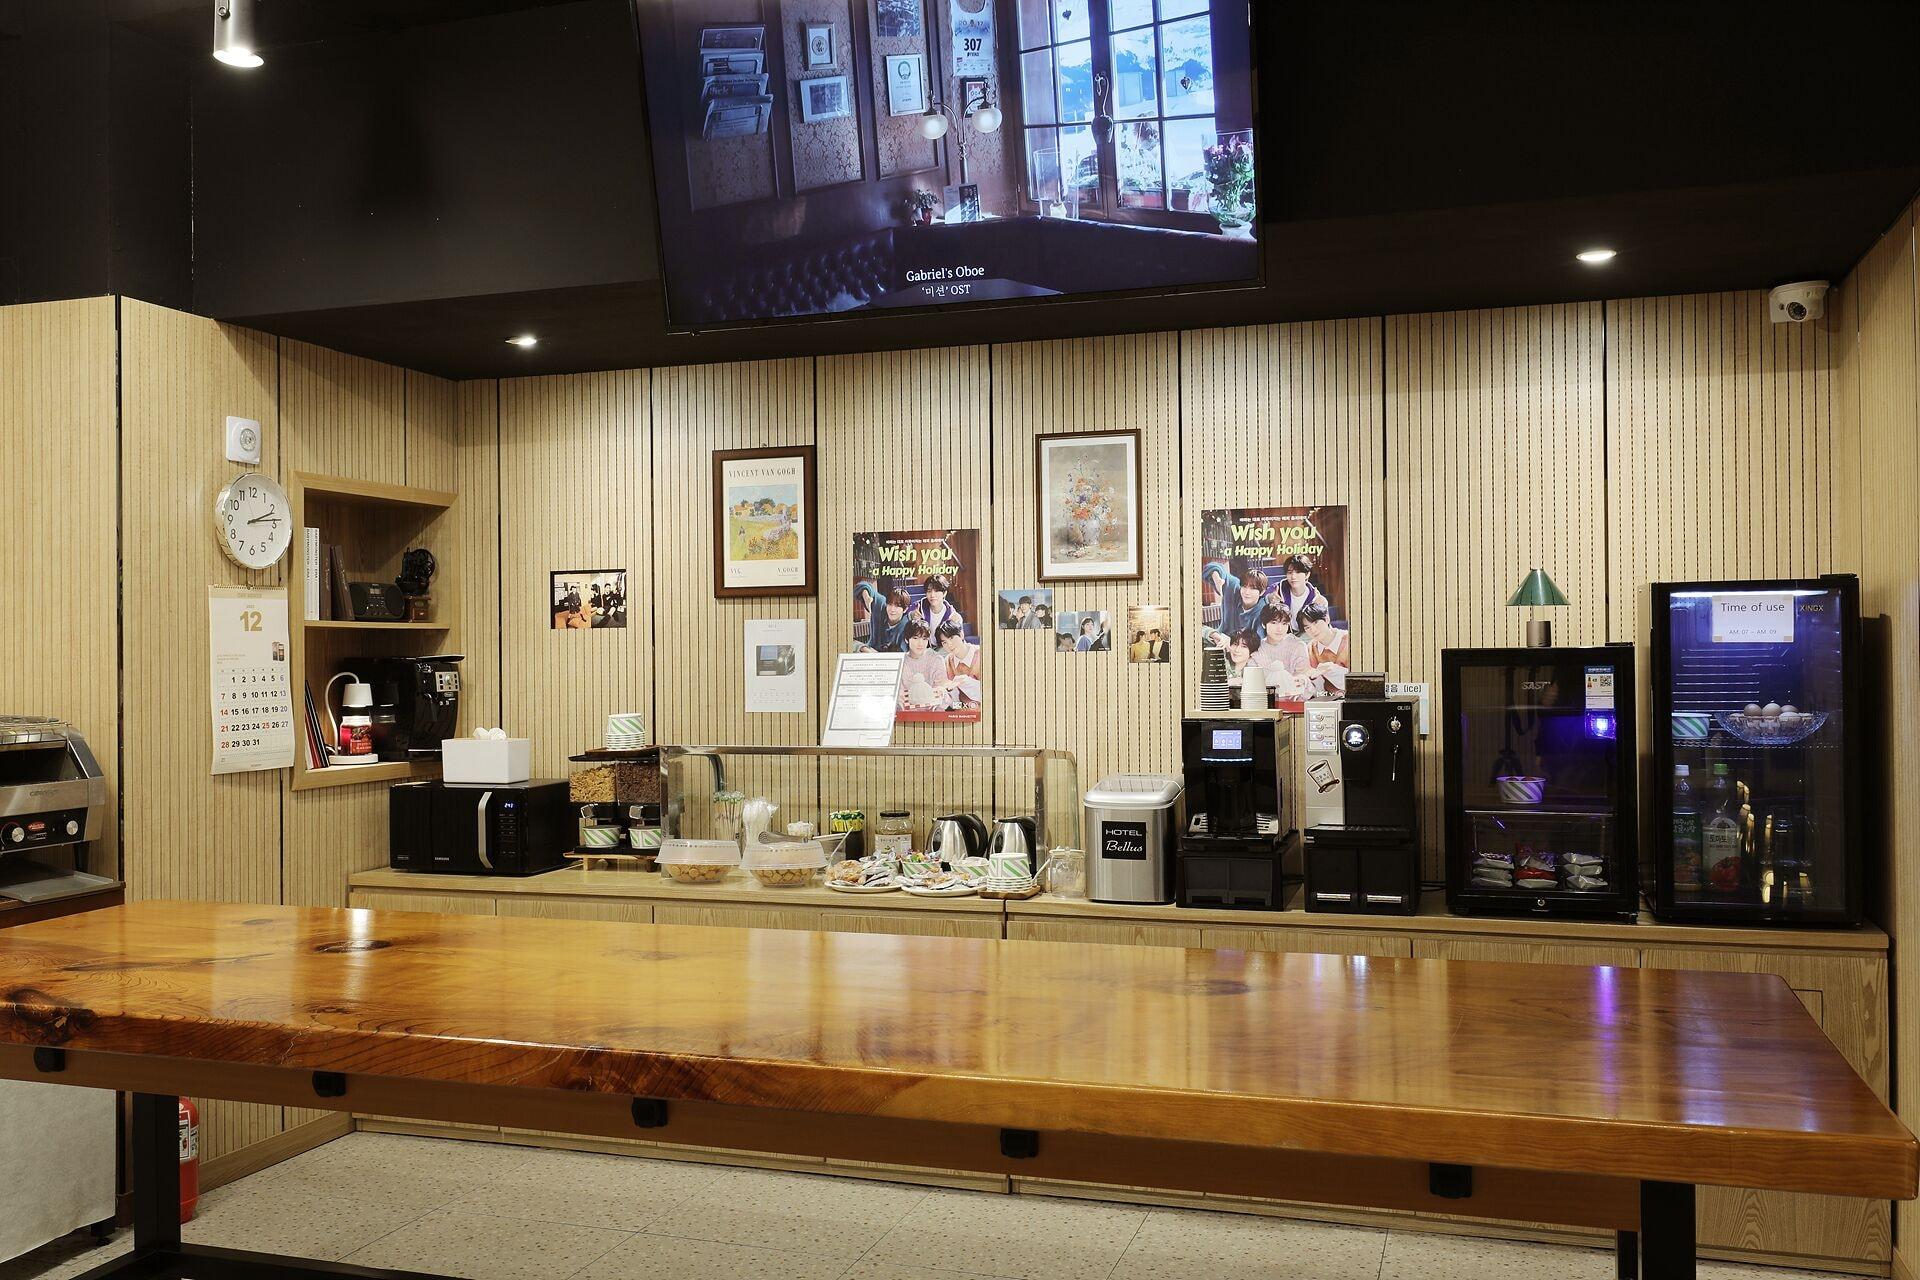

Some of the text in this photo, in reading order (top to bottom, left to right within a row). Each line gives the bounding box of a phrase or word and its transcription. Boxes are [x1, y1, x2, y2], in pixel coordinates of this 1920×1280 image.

[964, 38, 982, 51] 307
[906, 266, 985, 282] Gabriel's Oboe
[950, 284, 970, 294] OST
[728, 470, 758, 478] VINCENT
[777, 468, 796, 476] GOGH
[239, 490, 245, 501] 11
[249, 487, 257, 498] 12
[263, 493, 266, 503] 1
[230, 500, 239, 510] 10
[270, 504, 274, 514] 2
[228, 514, 233, 525] 9
[272, 519, 276, 529] 3
[230, 529, 236, 539] 8
[269, 532, 273, 542] 4
[1231, 522, 1316, 544] Wish you
[239, 540, 244, 551] 7
[249, 546, 255, 555] 6
[260, 542, 266, 552] 5
[1235, 545, 1274, 558] Happy
[1276, 542, 1324, 556] Holiday
[879, 544, 952, 564] Wish you
[882, 566, 915, 578] Happy
[918, 564, 959, 576] Holiday
[1720, 602, 1747, 612] Time
[1750, 602, 1762, 612] of
[240, 611, 262, 632] 12
[1404, 684, 1422, 693] (ice)
[1105, 828, 1142, 836] HOTEL
[1106, 840, 1143, 852] Bellus
